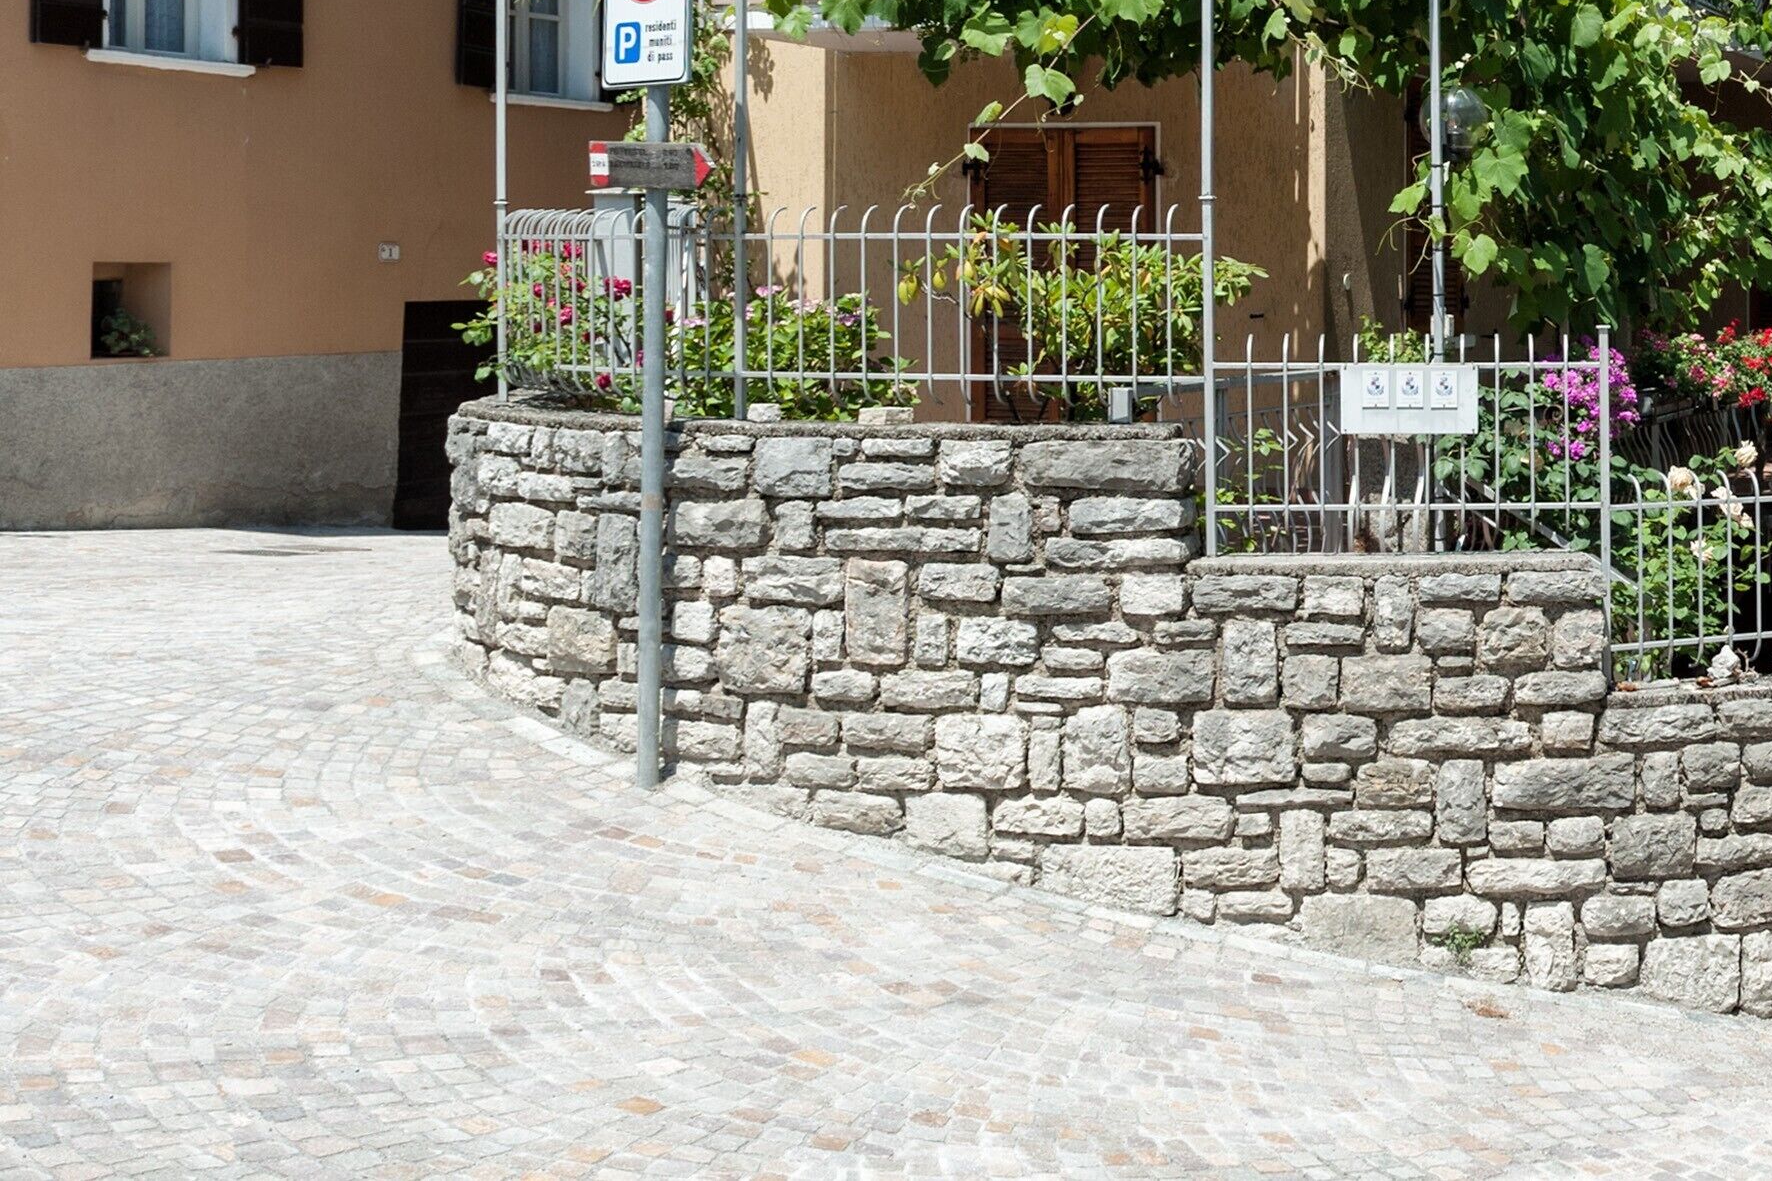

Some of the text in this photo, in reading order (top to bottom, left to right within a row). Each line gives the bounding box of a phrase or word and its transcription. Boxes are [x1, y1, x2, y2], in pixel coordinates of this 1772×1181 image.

[645, 20, 677, 32] residenti
[619, 27, 635, 60] P
[649, 36, 672, 47] muniti
[647, 52, 673, 64] di pass
